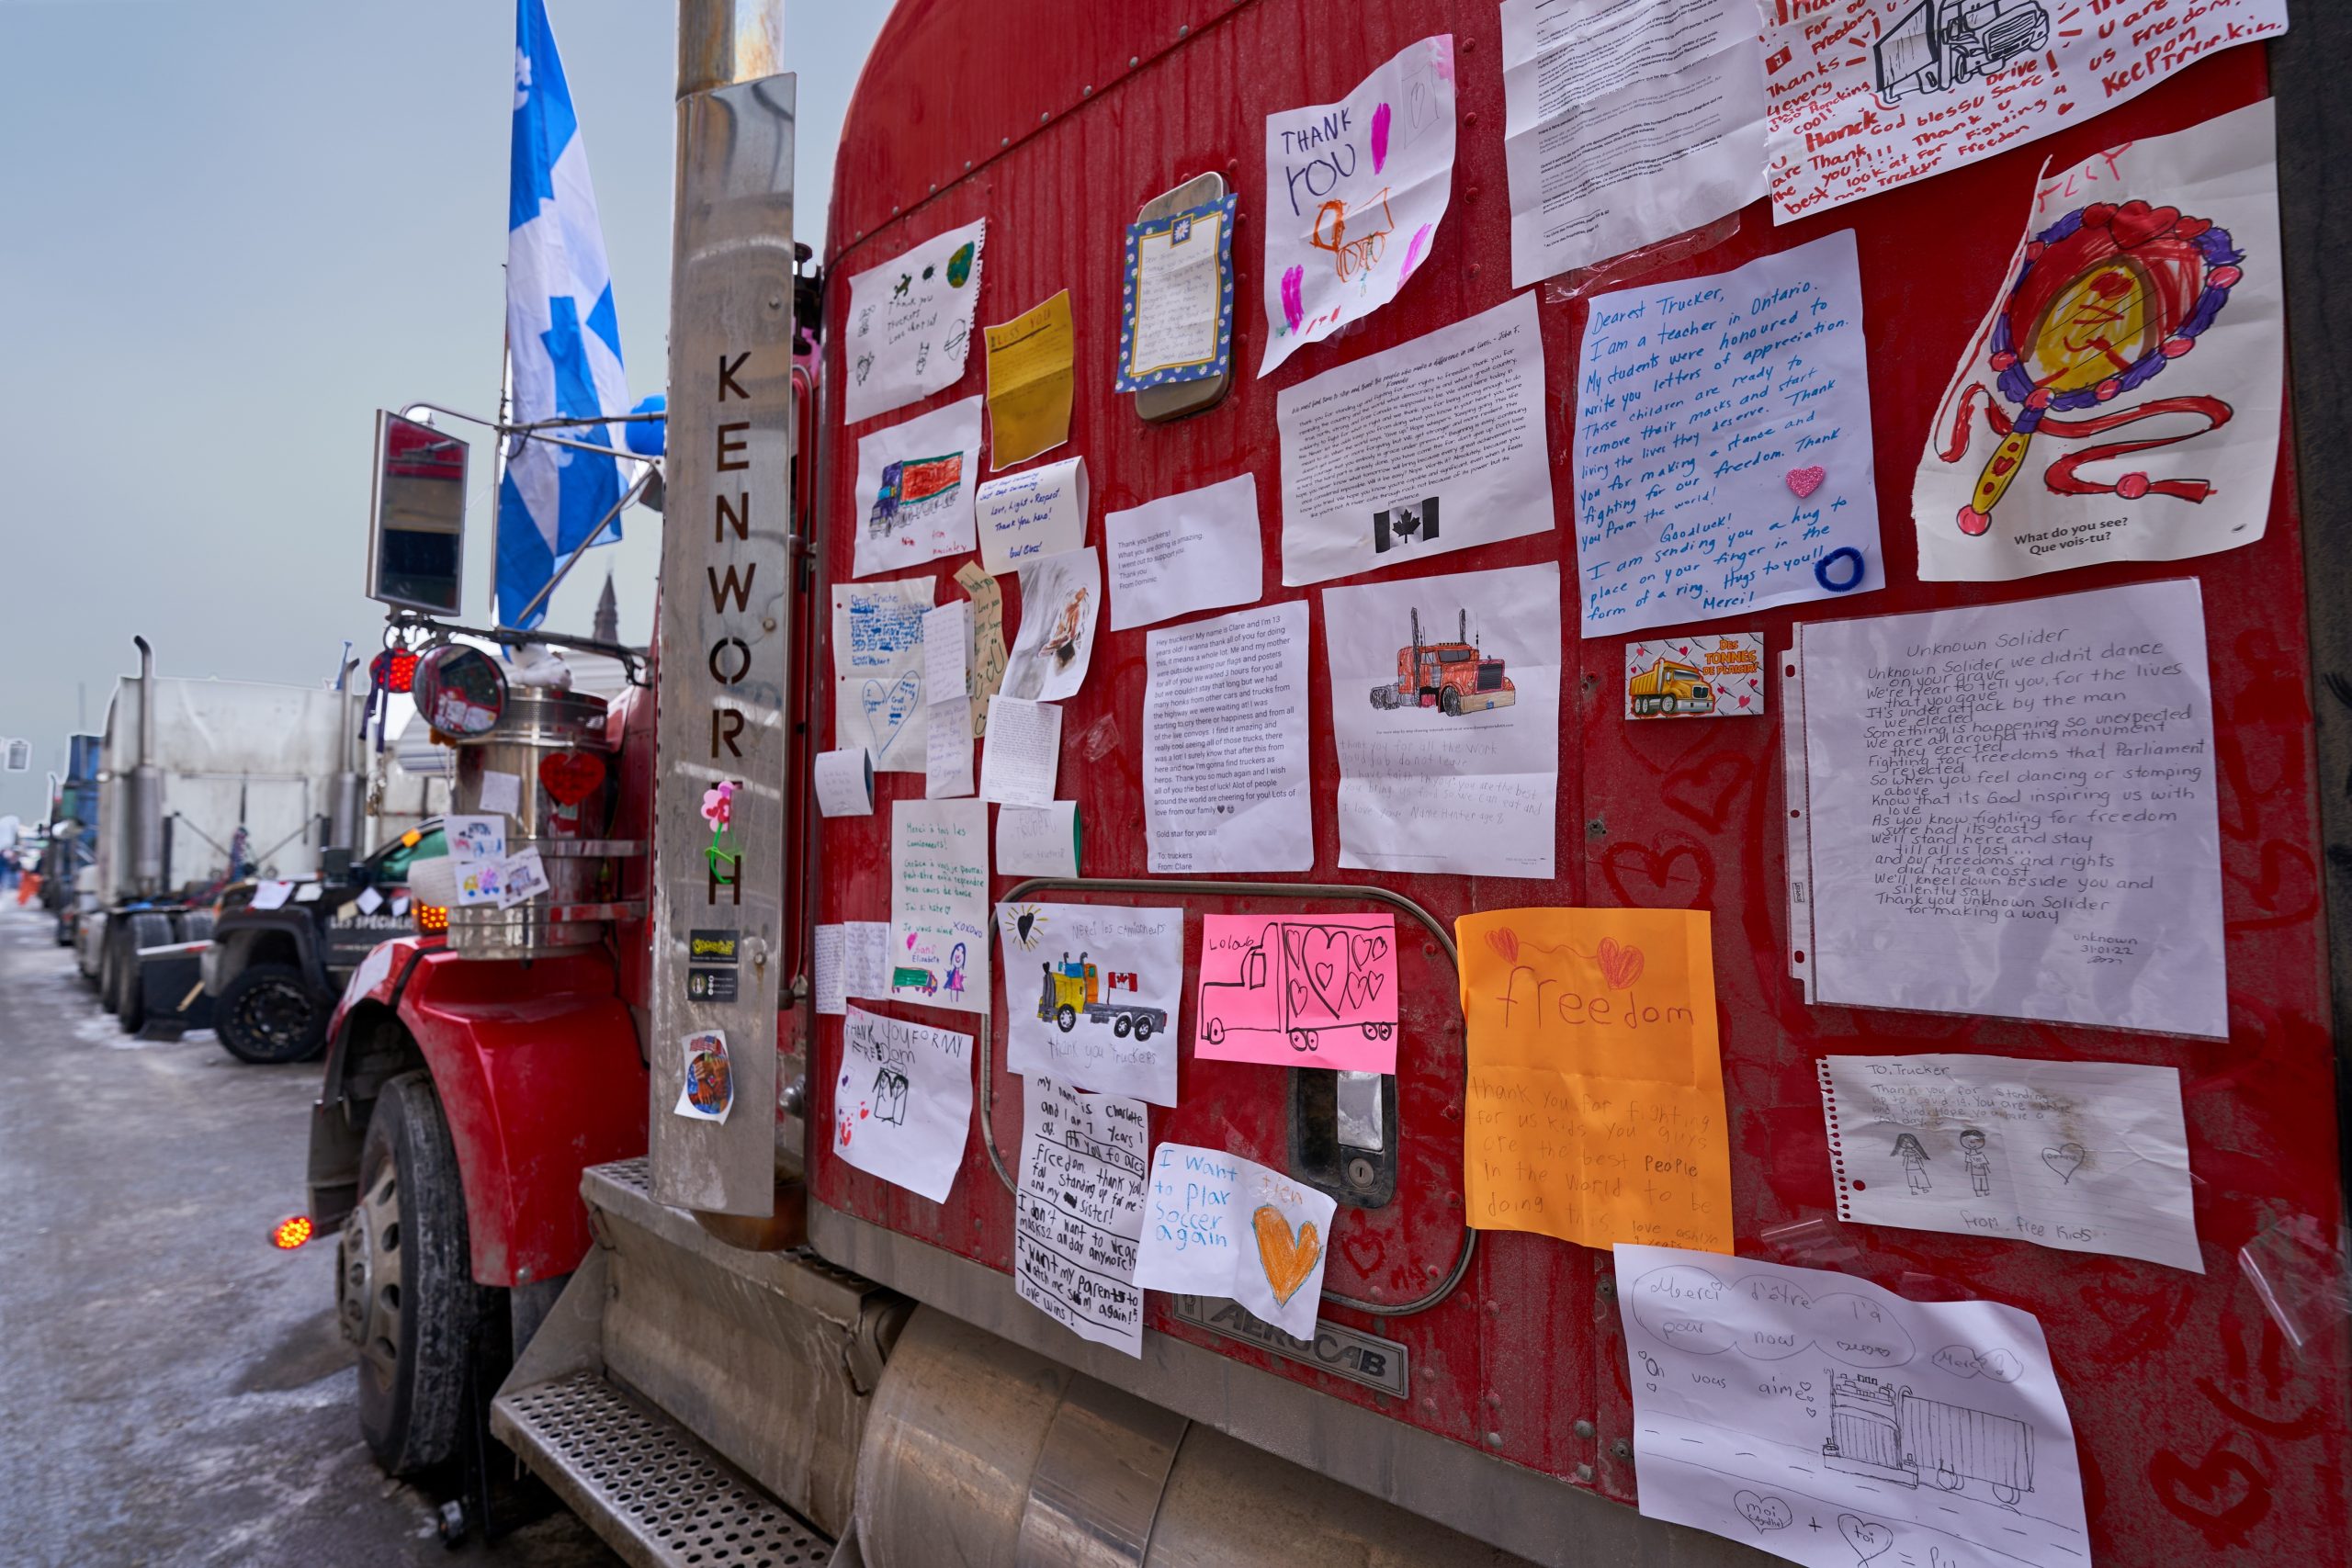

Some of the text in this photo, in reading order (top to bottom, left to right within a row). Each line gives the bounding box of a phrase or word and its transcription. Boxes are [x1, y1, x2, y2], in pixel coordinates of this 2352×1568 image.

[1281, 107, 1351, 154] THANK
[1808, 144, 1866, 171] Thank
[1286, 144, 1355, 216] YOU
[1590, 282, 1817, 361] I am teacher Ontario.
[1592, 288, 1724, 335] Dearest Trucker,
[1587, 297, 1827, 395] My students were honoured to
[1623, 320, 1849, 411] you letters appreciation.
[1629, 367, 1773, 422] children ready
[1784, 379, 1837, 405] Thank
[1641, 458, 1695, 483] making
[1784, 412, 1815, 429] and
[1584, 428, 1841, 528] fighting our freedom. Thank
[995, 520, 1015, 531] Thank
[1655, 506, 1820, 562] sending you hug
[2014, 517, 2128, 545] What do you see?
[1118, 540, 1136, 548] Thank
[1155, 542, 1170, 550] doing
[2030, 532, 2111, 556] Que vois-tu?
[1724, 569, 1756, 589] Hugs
[1702, 592, 1754, 609] Merci!
[707, 352, 756, 907] KENWORH
[1228, 624, 1245, 632] Clare
[1247, 620, 1260, 628] and
[1267, 627, 1285, 637] doing
[1720, 639, 1738, 650] DES
[1907, 628, 2069, 658] Unknown Solider
[1702, 661, 1758, 675] DE PLAISIR!
[1704, 649, 1757, 664] TONNES
[1868, 666, 1936, 680] Unknown
[1942, 658, 2004, 674] Solider
[2100, 642, 2164, 659] dance
[2096, 704, 2192, 727] unexpected
[2062, 722, 2165, 738] monument
[1972, 739, 2205, 764] freedoms that Parliament
[2018, 762, 2202, 786] dancing stomping
[1987, 784, 2195, 807] God inspiring with
[2087, 808, 2177, 822] freedom
[1168, 852, 1193, 860] truckers
[2060, 853, 2115, 872] rights
[2041, 896, 2110, 910] Solider
[1934, 907, 1998, 924] making
[1496, 965, 1693, 1029] freedom
[912, 1030, 938, 1048] FOR
[1159, 1149, 1174, 1168] I
[1155, 1180, 1173, 1194] to
[1156, 1224, 1227, 1250] again
[1662, 1321, 1707, 1340] pour
[1691, 1371, 1726, 1390] vous
[1758, 1376, 1807, 1400] aime
[1746, 1503, 1776, 1517] moi
[1854, 1525, 1874, 1543] toi
